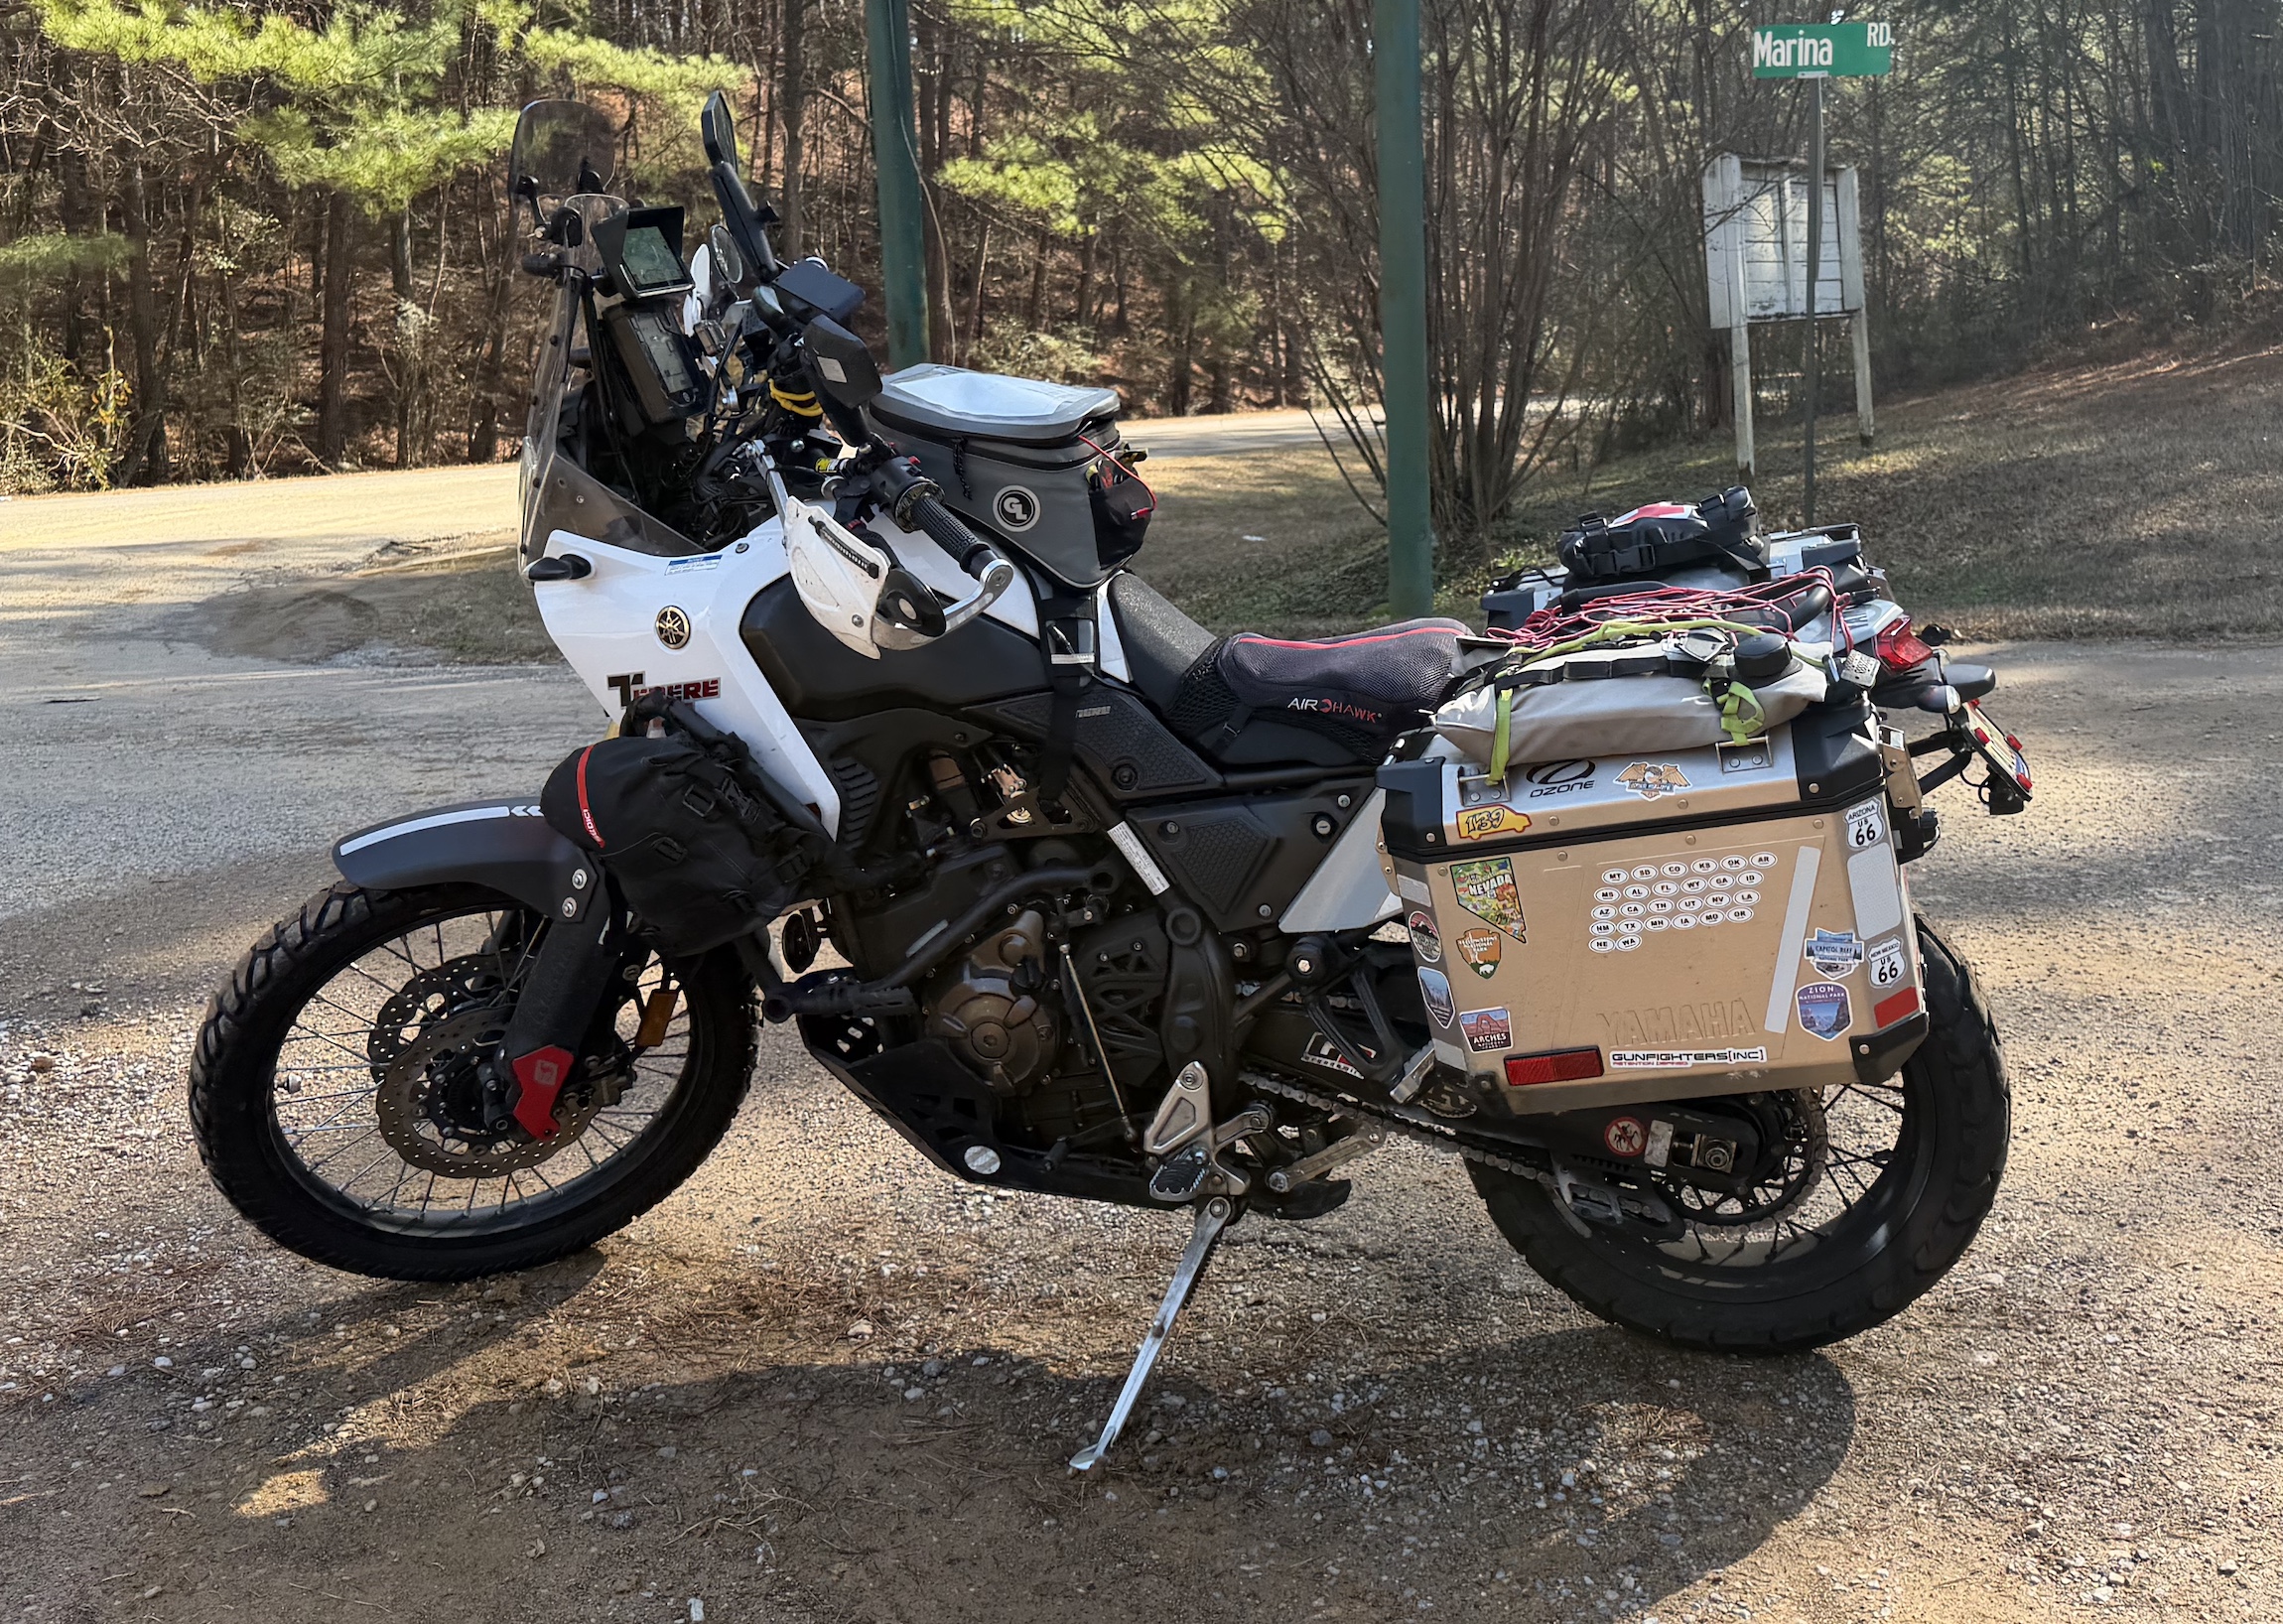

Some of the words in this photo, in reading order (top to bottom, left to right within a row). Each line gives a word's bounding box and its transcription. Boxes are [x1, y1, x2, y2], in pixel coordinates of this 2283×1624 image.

[1753, 30, 1833, 68] Marina
[1867, 22, 1891, 48] RD
[1003, 496, 1028, 520] GL
[1530, 779, 1596, 798] OZONE
[1464, 808, 1505, 833] 139
[1848, 804, 1876, 821] ARIZONA
[1855, 823, 1876, 846] 66
[1468, 874, 1513, 895] NEVADA
[1815, 945, 1838, 954] CAPITOL
[1878, 961, 1899, 983] 66
[1597, 998, 1756, 1048] YAMAHA
[1474, 1032, 1507, 1044] ARCHES
